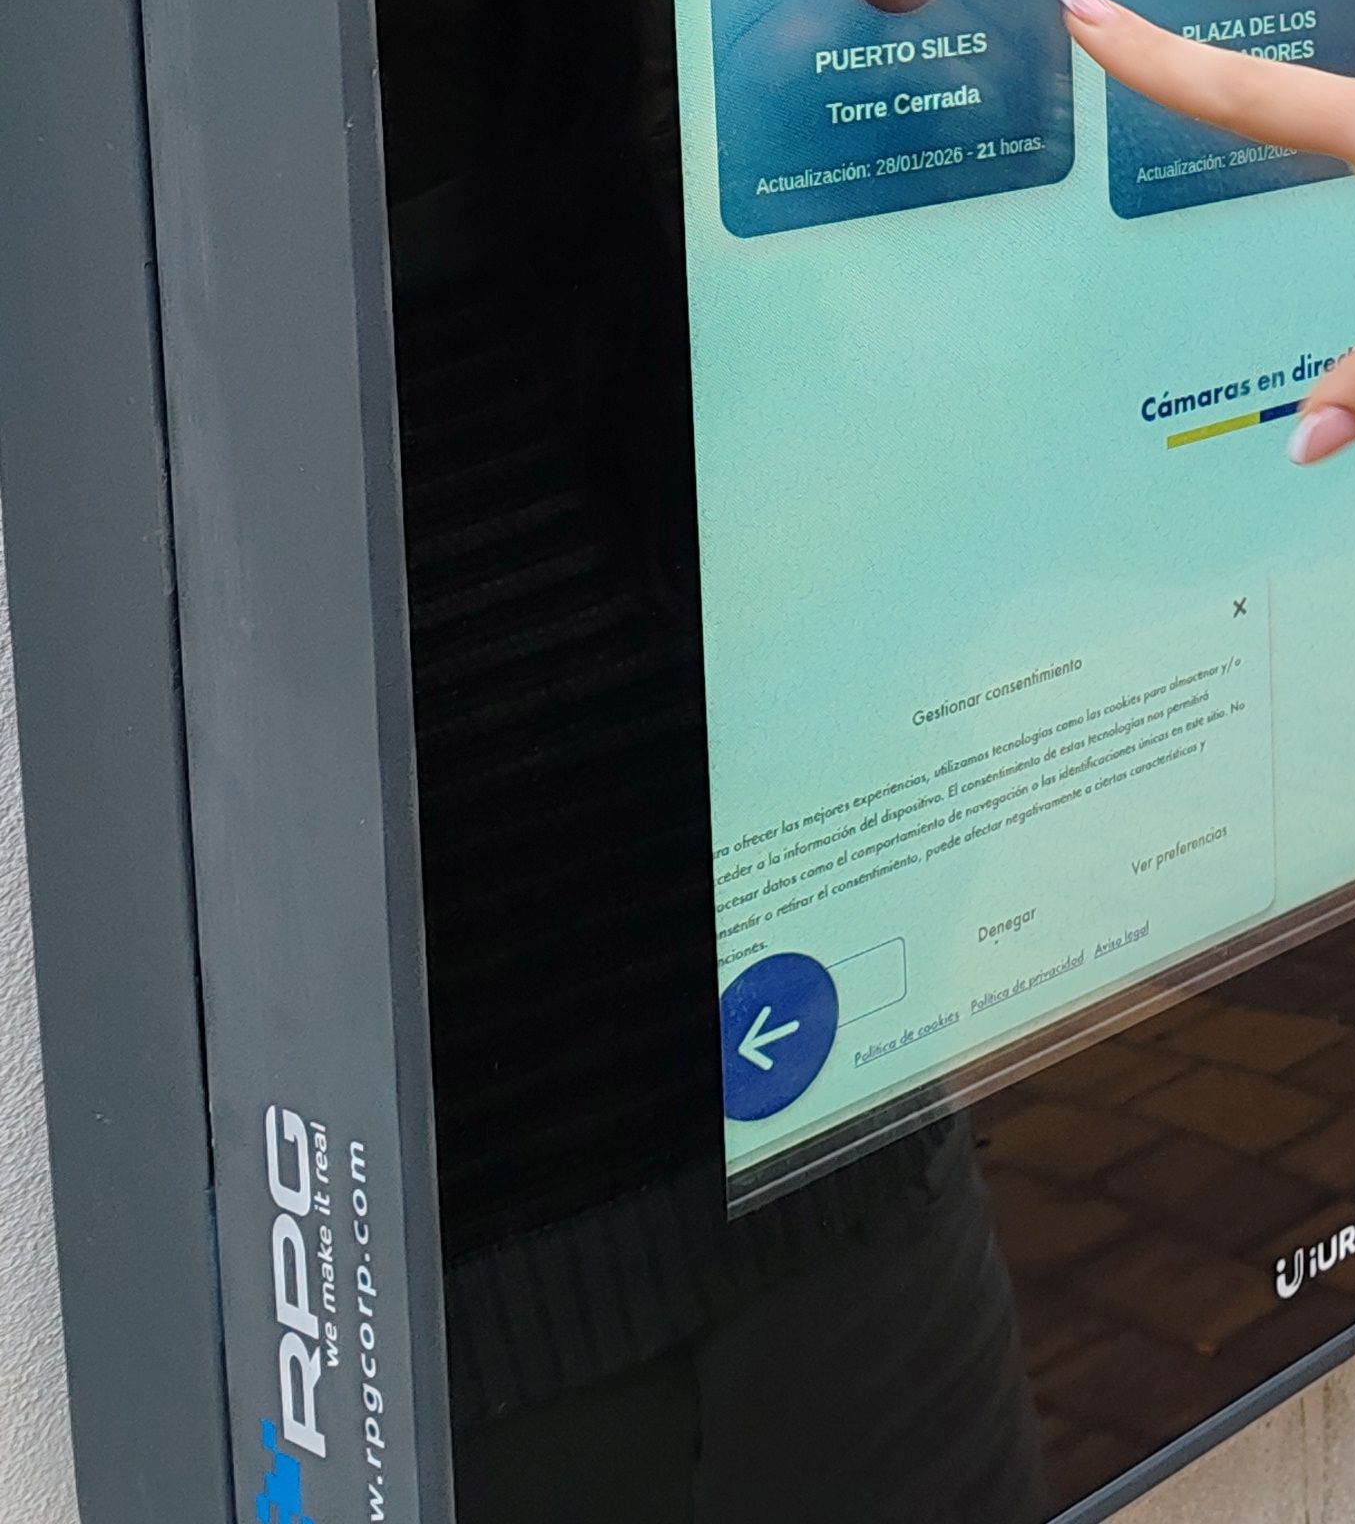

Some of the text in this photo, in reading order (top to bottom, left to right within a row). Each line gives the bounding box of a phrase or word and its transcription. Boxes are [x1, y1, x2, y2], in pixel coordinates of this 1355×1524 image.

[815, 32, 988, 74] PUERTO SILES
[1182, 10, 1317, 43] PLAZA DE LOS
[825, 84, 982, 125] Torre Cerrada
[756, 161, 871, 196] Actualización:
[876, 146, 964, 177] 28/01/2026
[976, 141, 997, 160] 21
[999, 135, 1047, 157] horas.
[1136, 154, 1226, 184] Actualización:
[1141, 379, 1250, 422] Cámaras
[1257, 370, 1286, 391] en
[912, 658, 1083, 727] Gestionar consentimiento
[734, 828, 778, 852] ofrecer
[781, 820, 800, 835] las
[803, 802, 850, 826] mejores
[853, 773, 931, 808] experiencias,
[934, 751, 989, 778] utilizamos
[992, 723, 1054, 756] tecnologías
[1056, 715, 1084, 733] como
[1086, 707, 1101, 722] las
[1104, 694, 1141, 716] cookies
[1144, 684, 1167, 704] para
[1169, 665, 1219, 691] almacenar
[1220, 655, 1241, 677] y/o
[757, 860, 765, 871] a
[768, 852, 781, 867] la
[783, 826, 856, 861] información
[860, 815, 878, 832] del
[881, 794, 945, 824] dispositivo.
[948, 783, 959, 798] El
[961, 756, 1041, 794] consentimiento
[1044, 747, 1057, 762] de
[1060, 739, 1085, 756] estas
[1087, 714, 1146, 746] tecnologías
[1147, 709, 1164, 723] nos
[1166, 689, 1209, 717] permitirá
[762, 874, 797, 897] datos
[800, 862, 834, 882] como
[837, 850, 848, 867] el
[851, 818, 945, 862] comportamiento
[948, 808, 963, 824] de
[965, 781, 1029, 817] navegación
[1031, 782, 1039, 792] o
[1041, 773, 1057, 788] las
[1059, 745, 1136, 782] identificaciones
[1138, 729, 1169, 750] únicas
[1171, 725, 1184, 737] en
[1186, 716, 1205, 732] este
[1230, 700, 1246, 715] No
[764, 912, 773, 922] o
[776, 894, 815, 917] retirar
[817, 885, 829, 901] el
[831, 853, 922, 896] consentimiento,
[925, 836, 961, 861] puede
[964, 821, 1002, 843] afectar
[1005, 788, 1082, 826] negativamente
[1085, 785, 1092, 795] a
[1094, 771, 1127, 791] ciertas
[1130, 744, 1198, 777] características
[1199, 739, 1207, 754] y
[1131, 825, 1228, 875] Ver preferencias
[978, 907, 1037, 943] Denegar
[1094, 920, 1150, 958] Aviso legal
[971, 949, 1084, 1013] Política de privacidad
[855, 1010, 960, 1067] Política de cookies
[309, 1120, 341, 1368] we make it real
[265, 1104, 326, 1458] RPG
